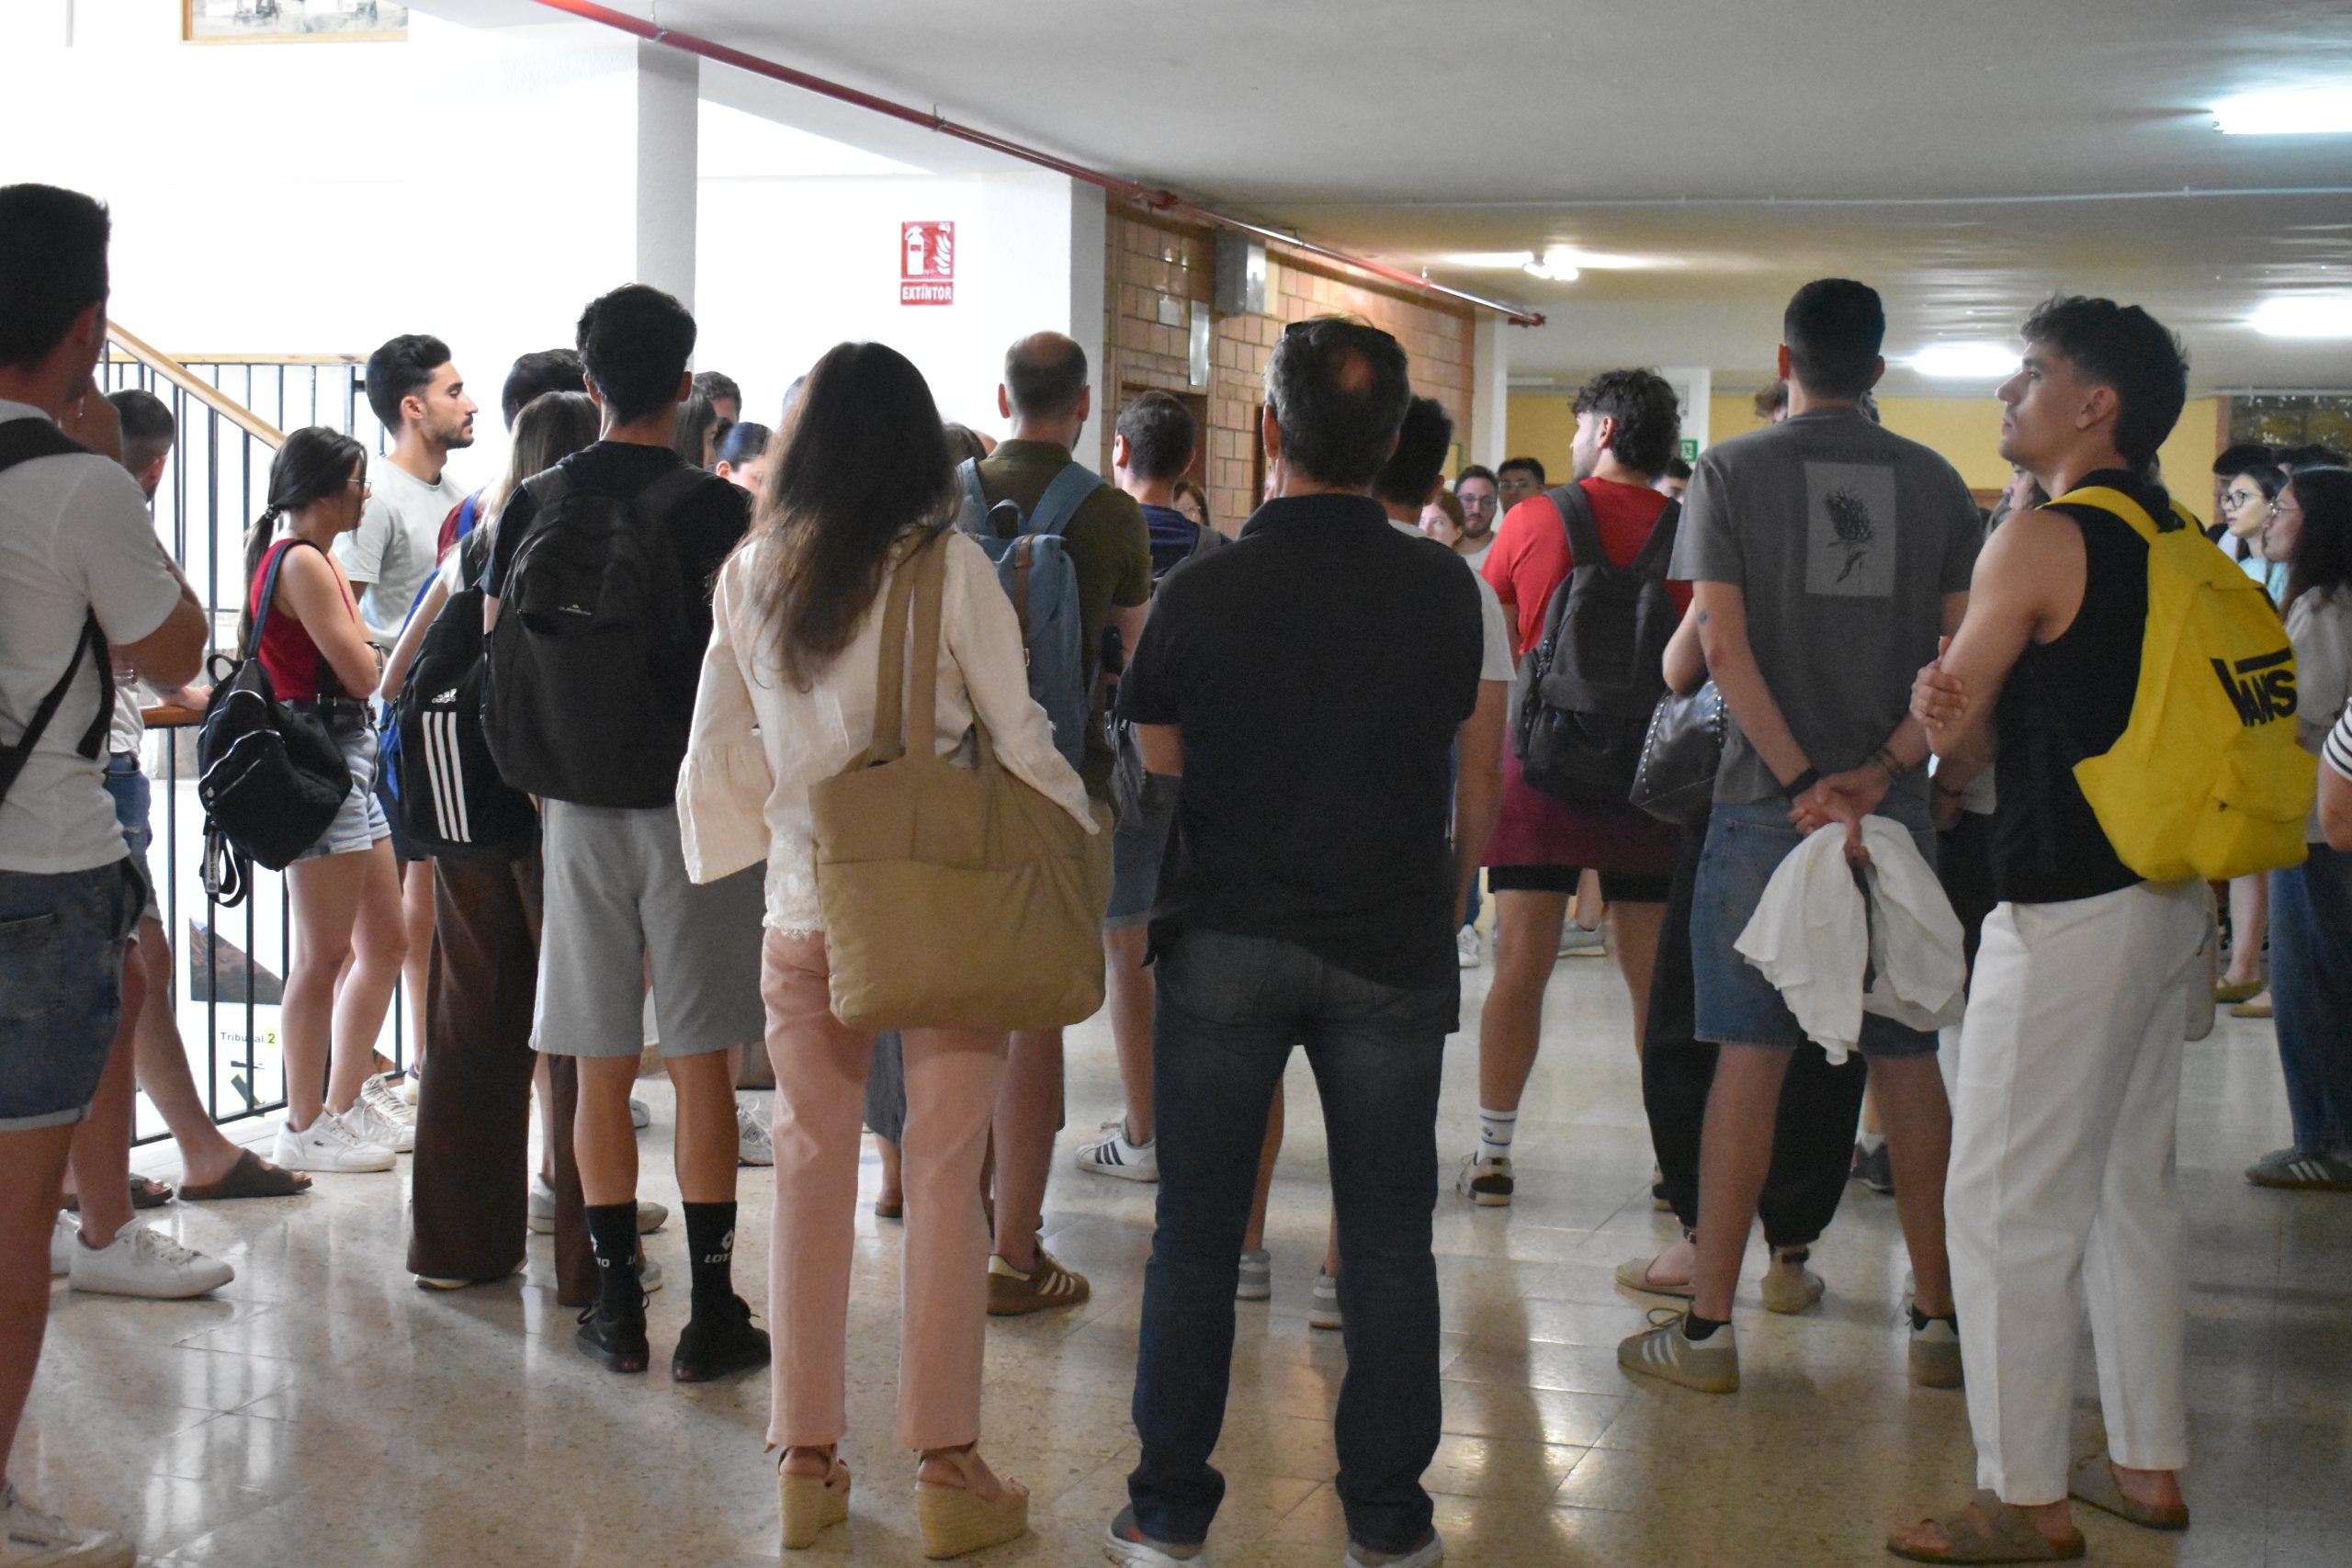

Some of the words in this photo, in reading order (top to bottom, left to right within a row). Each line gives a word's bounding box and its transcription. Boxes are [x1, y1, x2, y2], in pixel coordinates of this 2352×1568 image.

[902, 286, 952, 300] EXTINTOR
[2210, 647, 2298, 728] VANS
[220, 1032, 264, 1043] Tribual
[267, 1032, 276, 1044] 2
[704, 1252, 731, 1264] LOT
